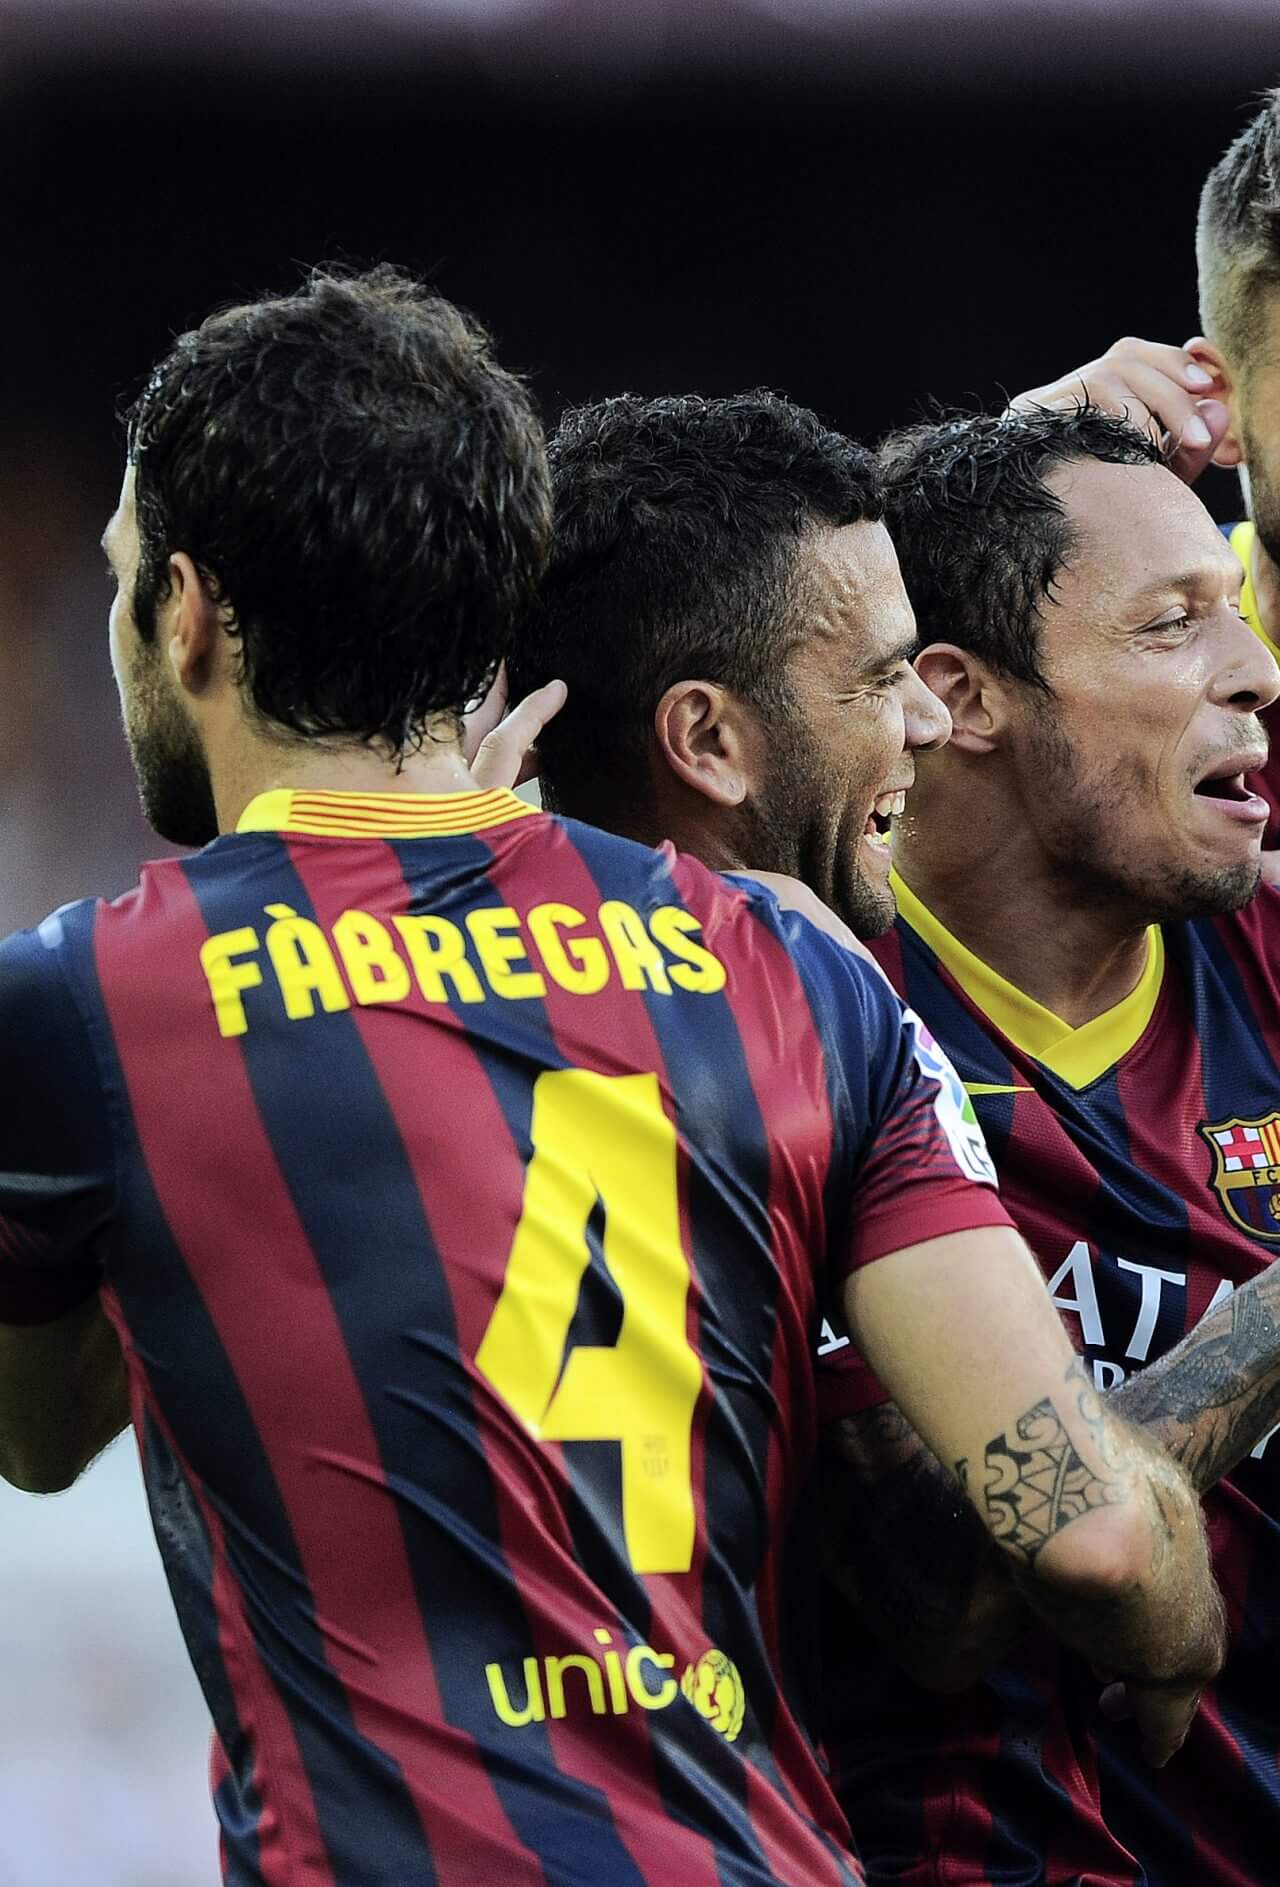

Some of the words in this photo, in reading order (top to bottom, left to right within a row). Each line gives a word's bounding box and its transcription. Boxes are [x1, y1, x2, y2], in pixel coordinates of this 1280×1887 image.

[200, 901, 727, 1038] FÀBREGAS
[477, 1068, 703, 1573] 4
[485, 1628, 678, 1728] unic
